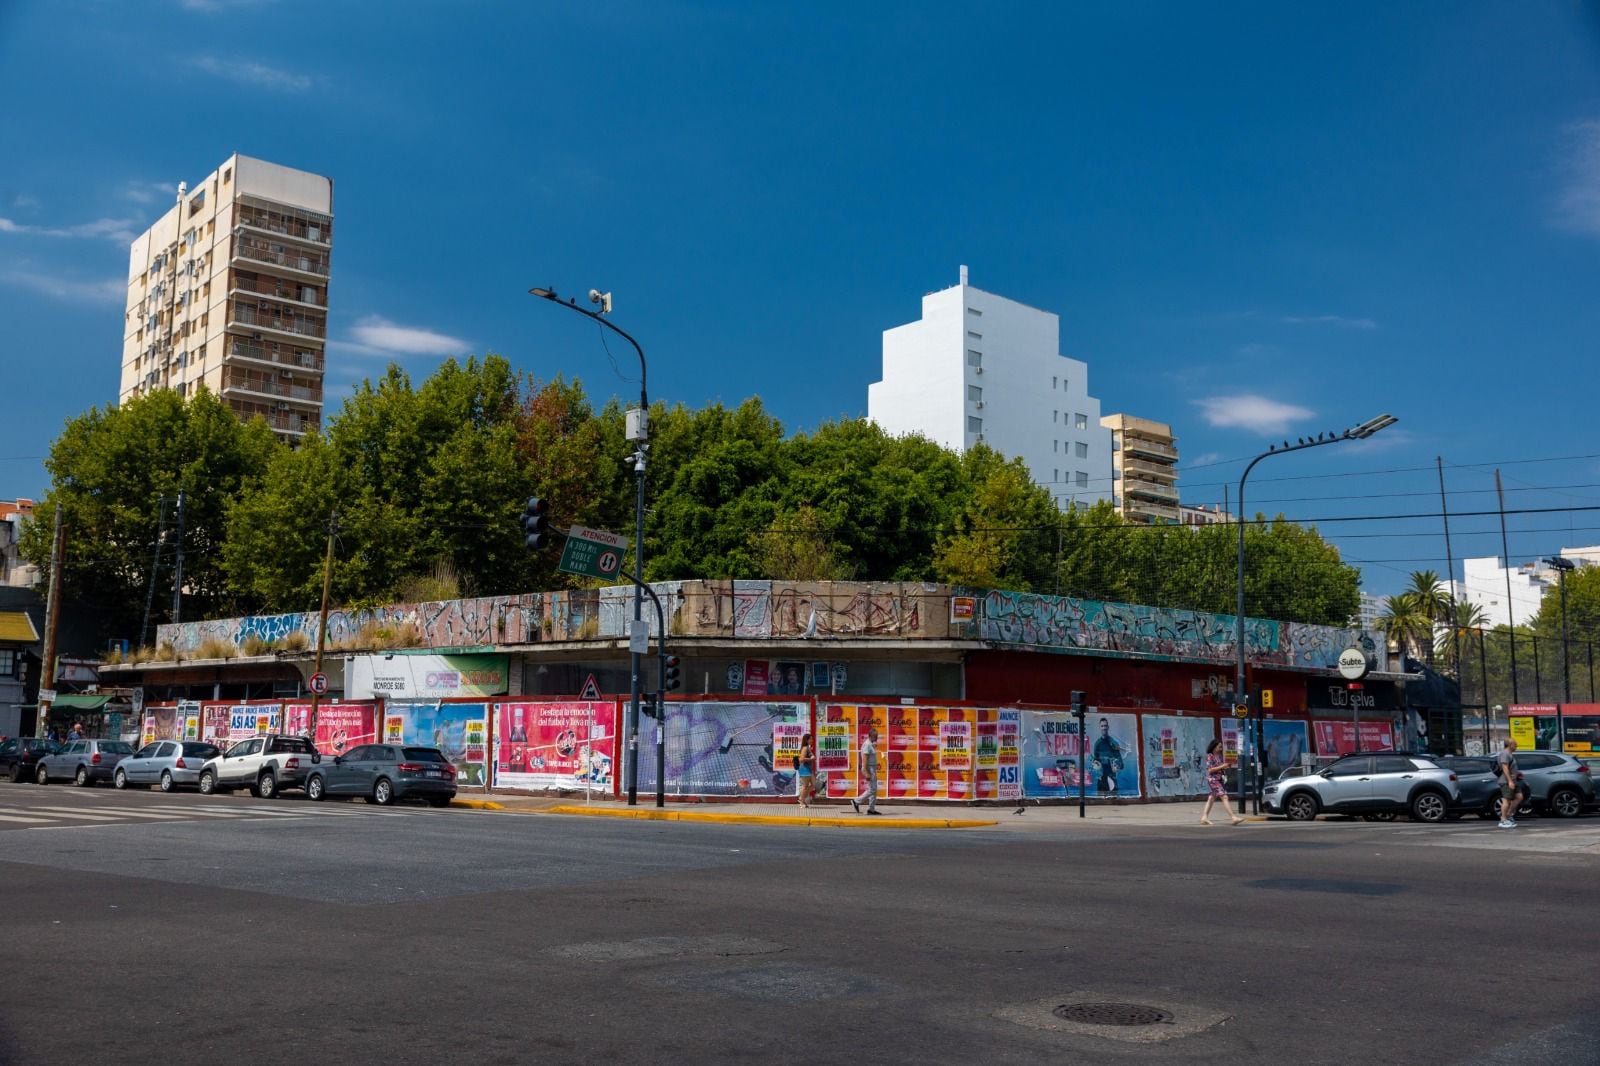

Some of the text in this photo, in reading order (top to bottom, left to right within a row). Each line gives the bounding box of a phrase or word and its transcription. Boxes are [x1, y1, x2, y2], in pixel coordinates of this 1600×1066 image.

[580, 530, 618, 544] ATENCION
[1350, 691, 1375, 706] selva
[231, 716, 243, 728] ASI
[244, 716, 256, 728] ASI
[1056, 720, 1078, 734] DUEÑOS
[782, 737, 798, 749] BOXEO
[825, 738, 842, 749] BOXEO
[947, 736, 963, 748] BOXEO
[1055, 735, 1090, 755] PELOA
[999, 767, 1017, 783] ASI
